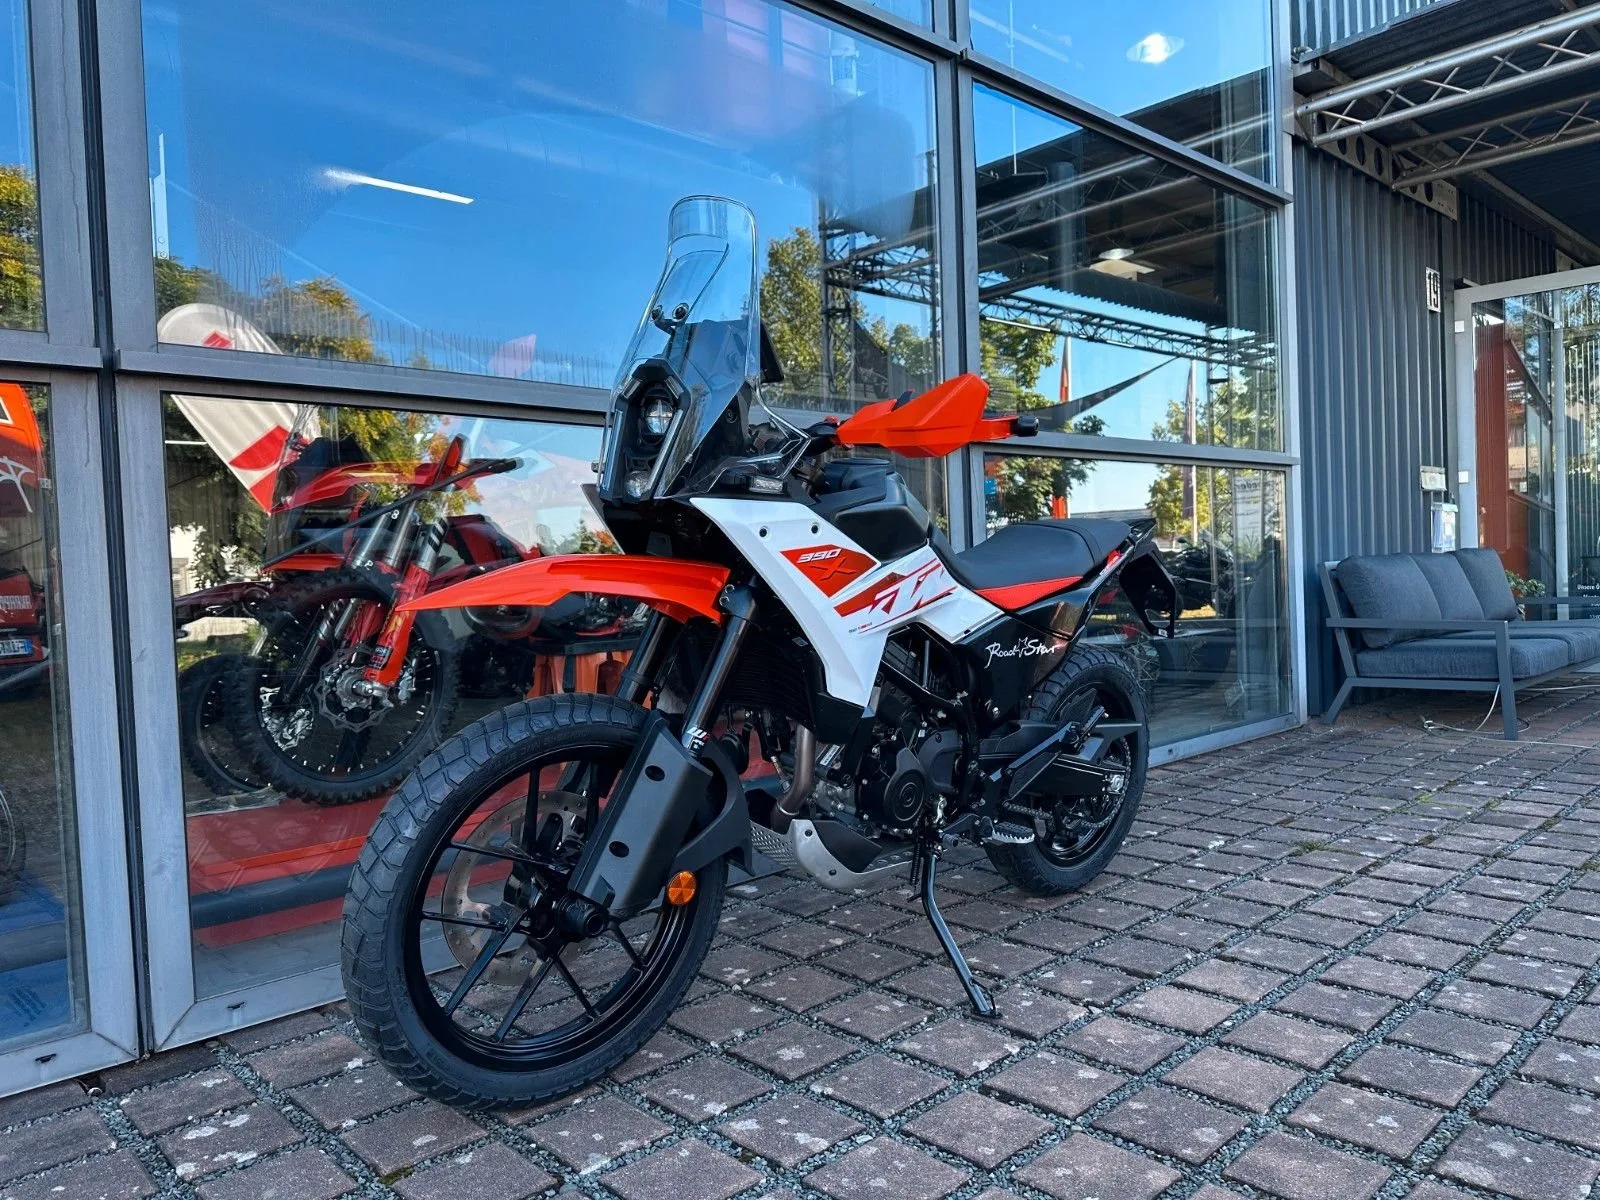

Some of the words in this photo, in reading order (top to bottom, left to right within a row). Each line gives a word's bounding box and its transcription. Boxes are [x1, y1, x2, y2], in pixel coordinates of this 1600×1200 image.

[1428, 272, 1438, 308] 19
[796, 548, 842, 564] 390
[984, 642, 1017, 669] Road
[1024, 639, 1067, 656] Star
